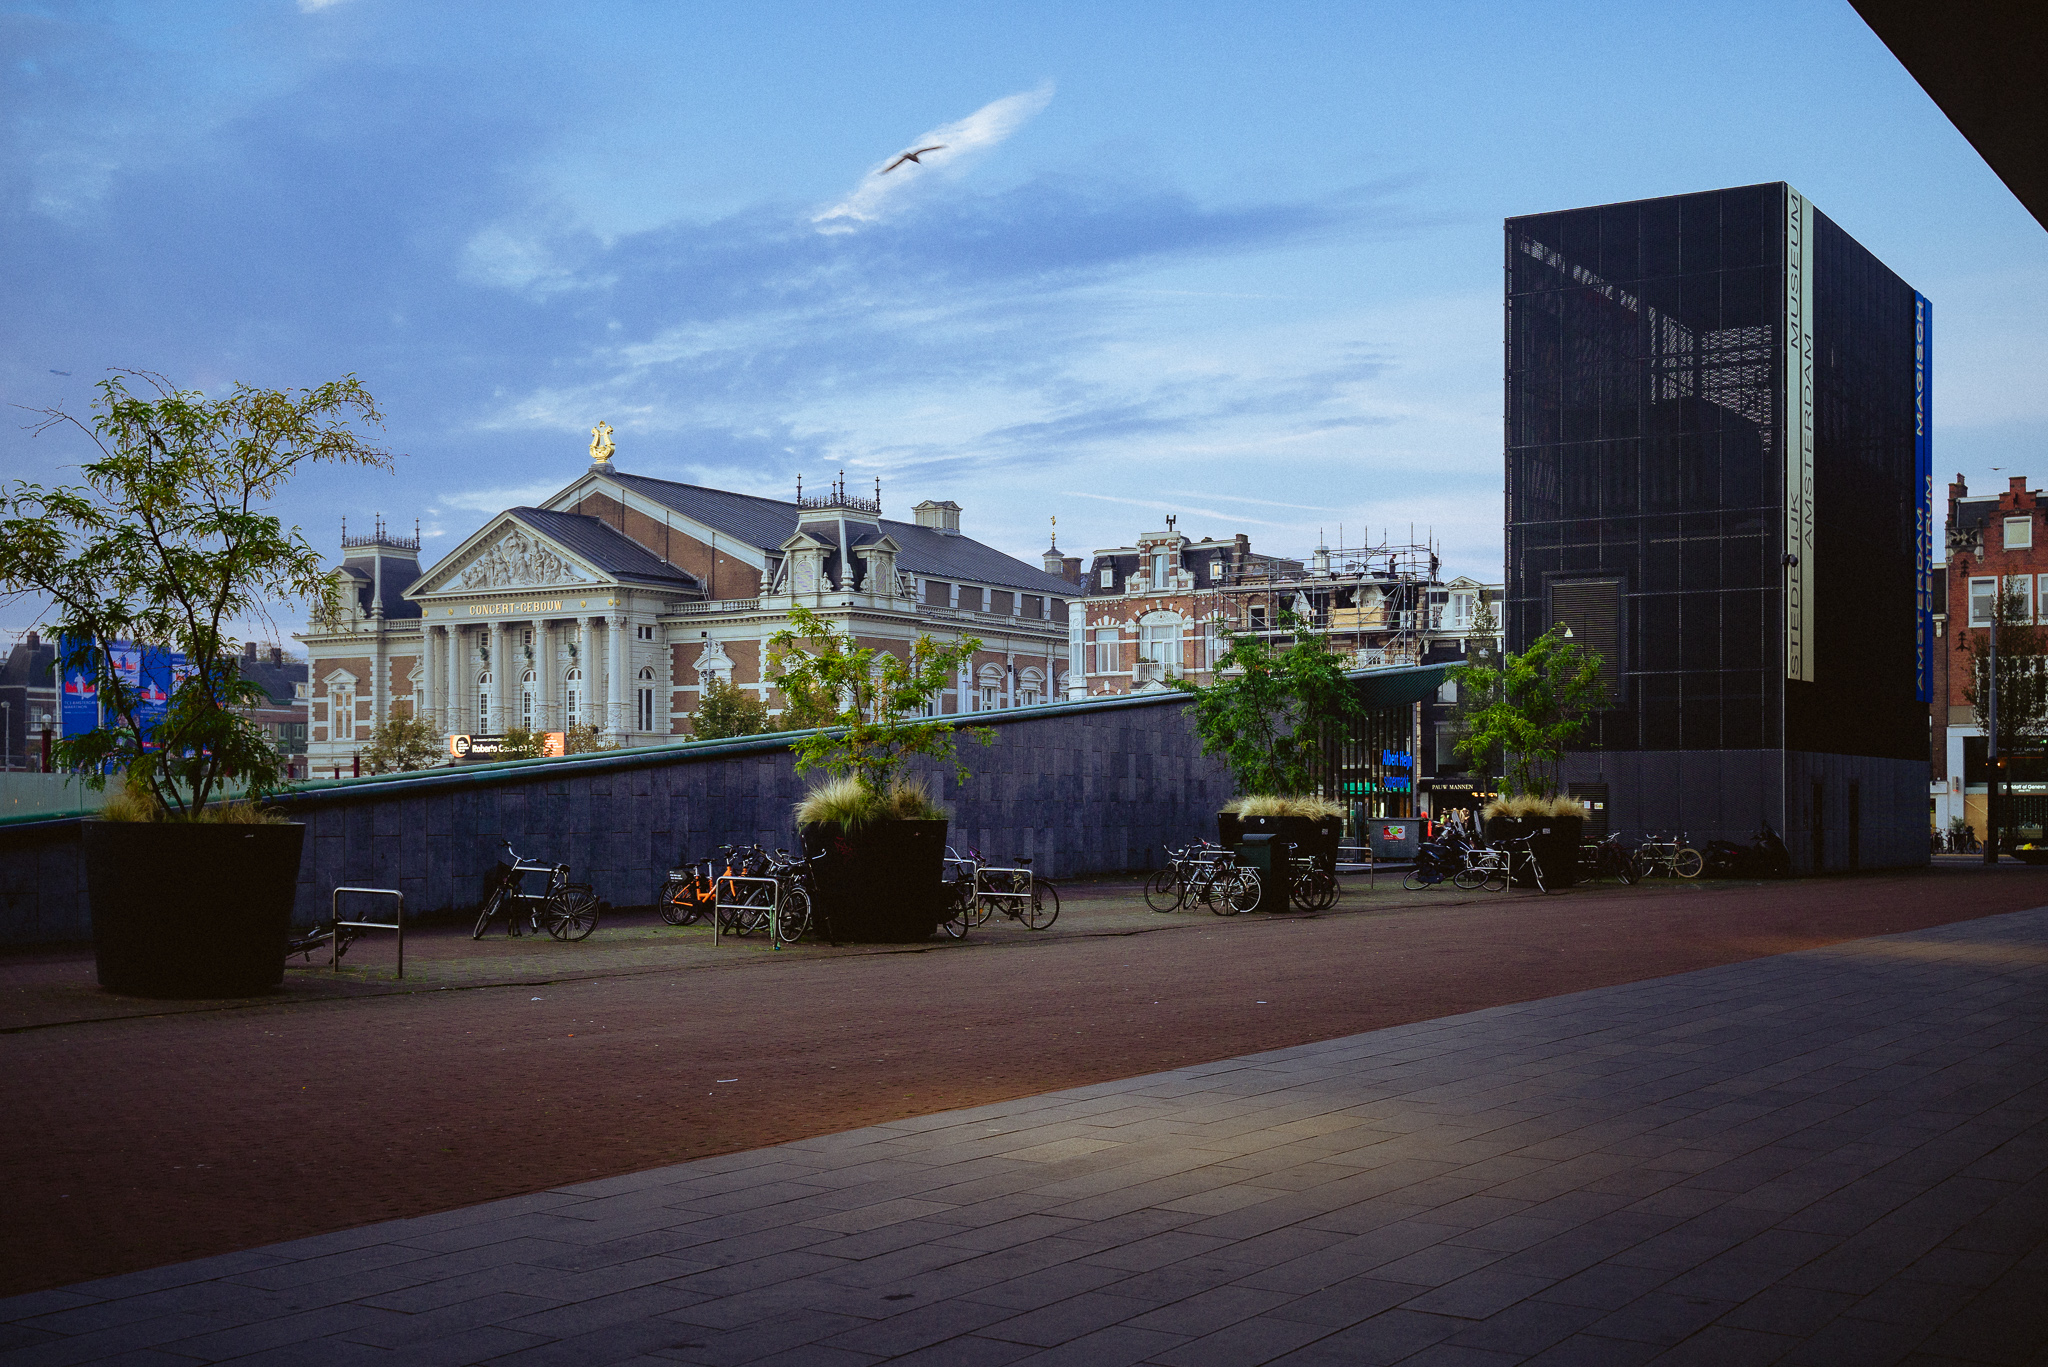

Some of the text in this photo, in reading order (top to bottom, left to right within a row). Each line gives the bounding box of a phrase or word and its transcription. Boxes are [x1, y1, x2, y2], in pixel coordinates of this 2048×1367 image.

[1791, 193, 1799, 349] MUSEUM
[1804, 333, 1812, 550] AMSTERDAM
[1916, 300, 1924, 691] AMSTERDAM MAGISCH
[1925, 474, 1933, 613] CENTRUM
[472, 744, 498, 753] Roberto
[1382, 749, 1412, 770] Albert Heijn
[1384, 774, 1409, 791] supermarkt
